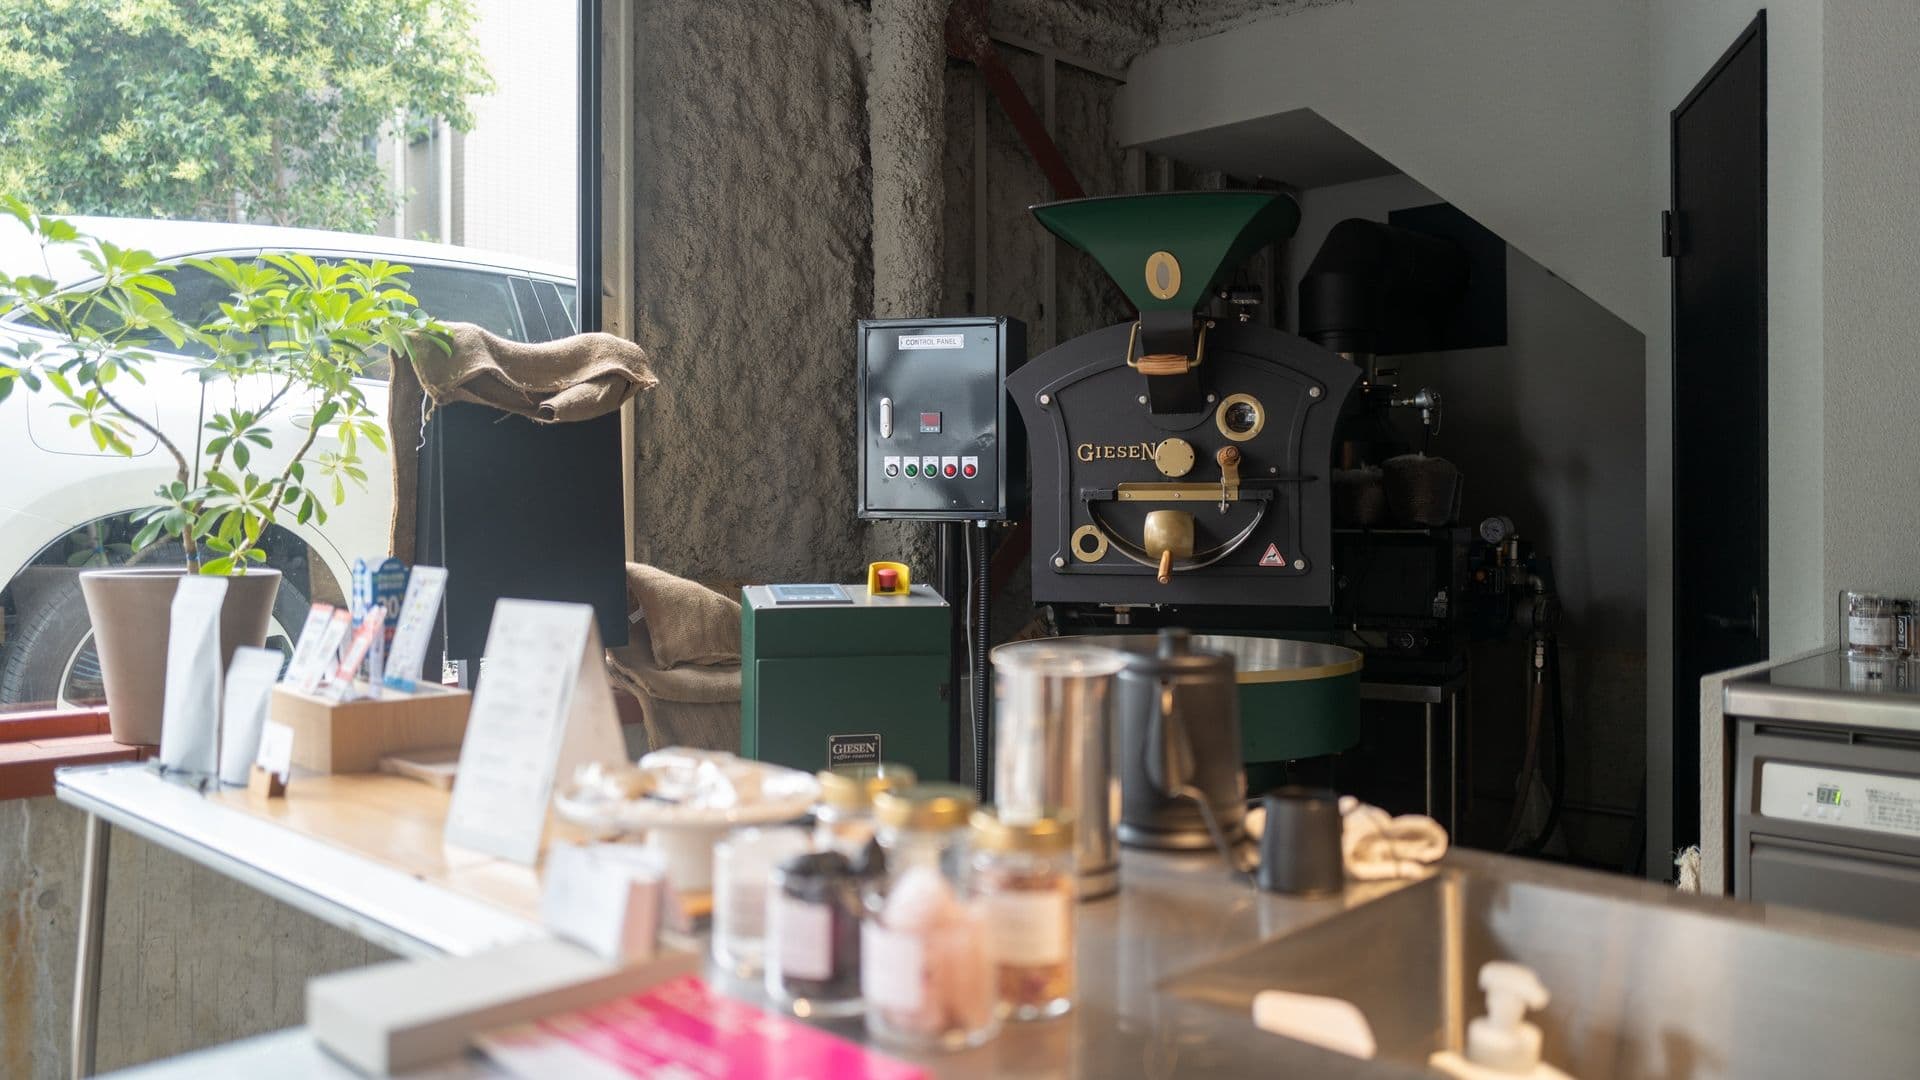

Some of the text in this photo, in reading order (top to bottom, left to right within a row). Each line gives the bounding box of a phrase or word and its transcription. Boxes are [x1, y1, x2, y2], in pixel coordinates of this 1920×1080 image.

[905, 337, 957, 346] CONTROL PANEL
[1077, 442, 1156, 462] GIESEN
[832, 743, 875, 755] GIESEN
